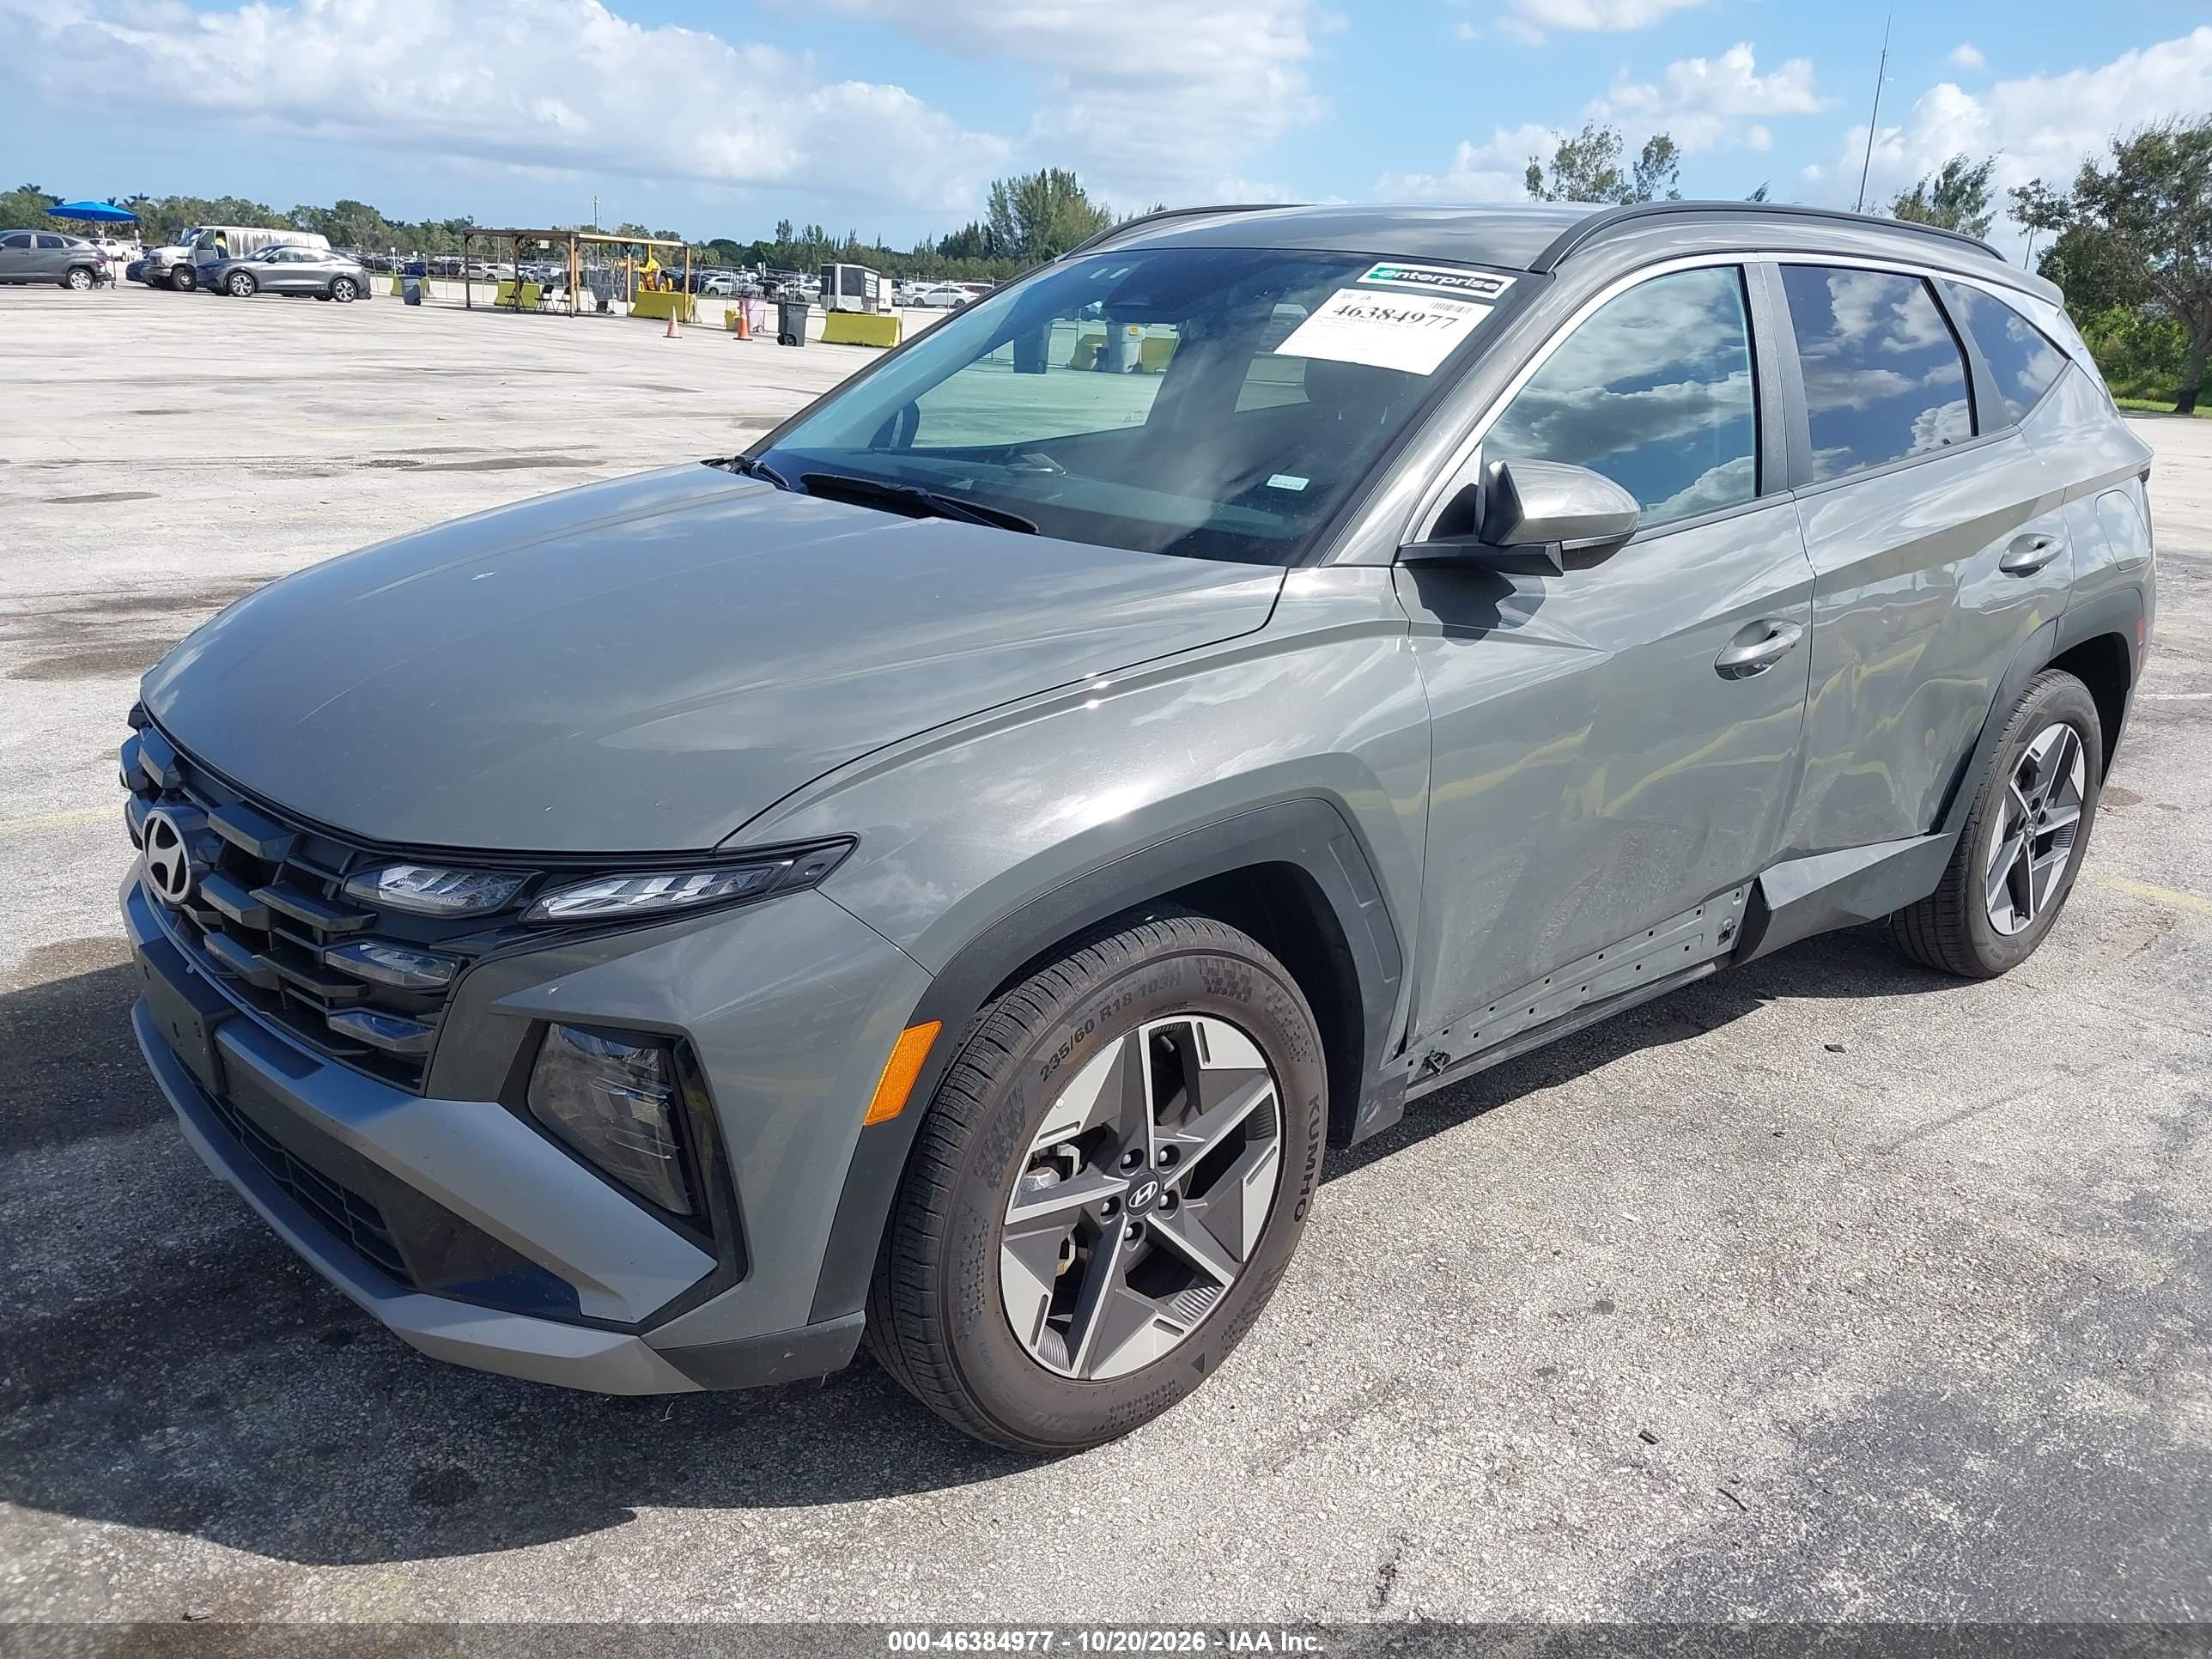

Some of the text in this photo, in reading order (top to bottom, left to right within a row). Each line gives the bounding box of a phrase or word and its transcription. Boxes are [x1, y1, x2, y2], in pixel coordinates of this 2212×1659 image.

[1377, 270, 1500, 290] enterprise
[1333, 303, 1459, 330] 46384977
[1040, 1018, 1095, 1082] 235/60
[1099, 992, 1133, 1024] R18
[1139, 972, 1182, 997] 103H
[1294, 1093, 1320, 1223] KUMHO
